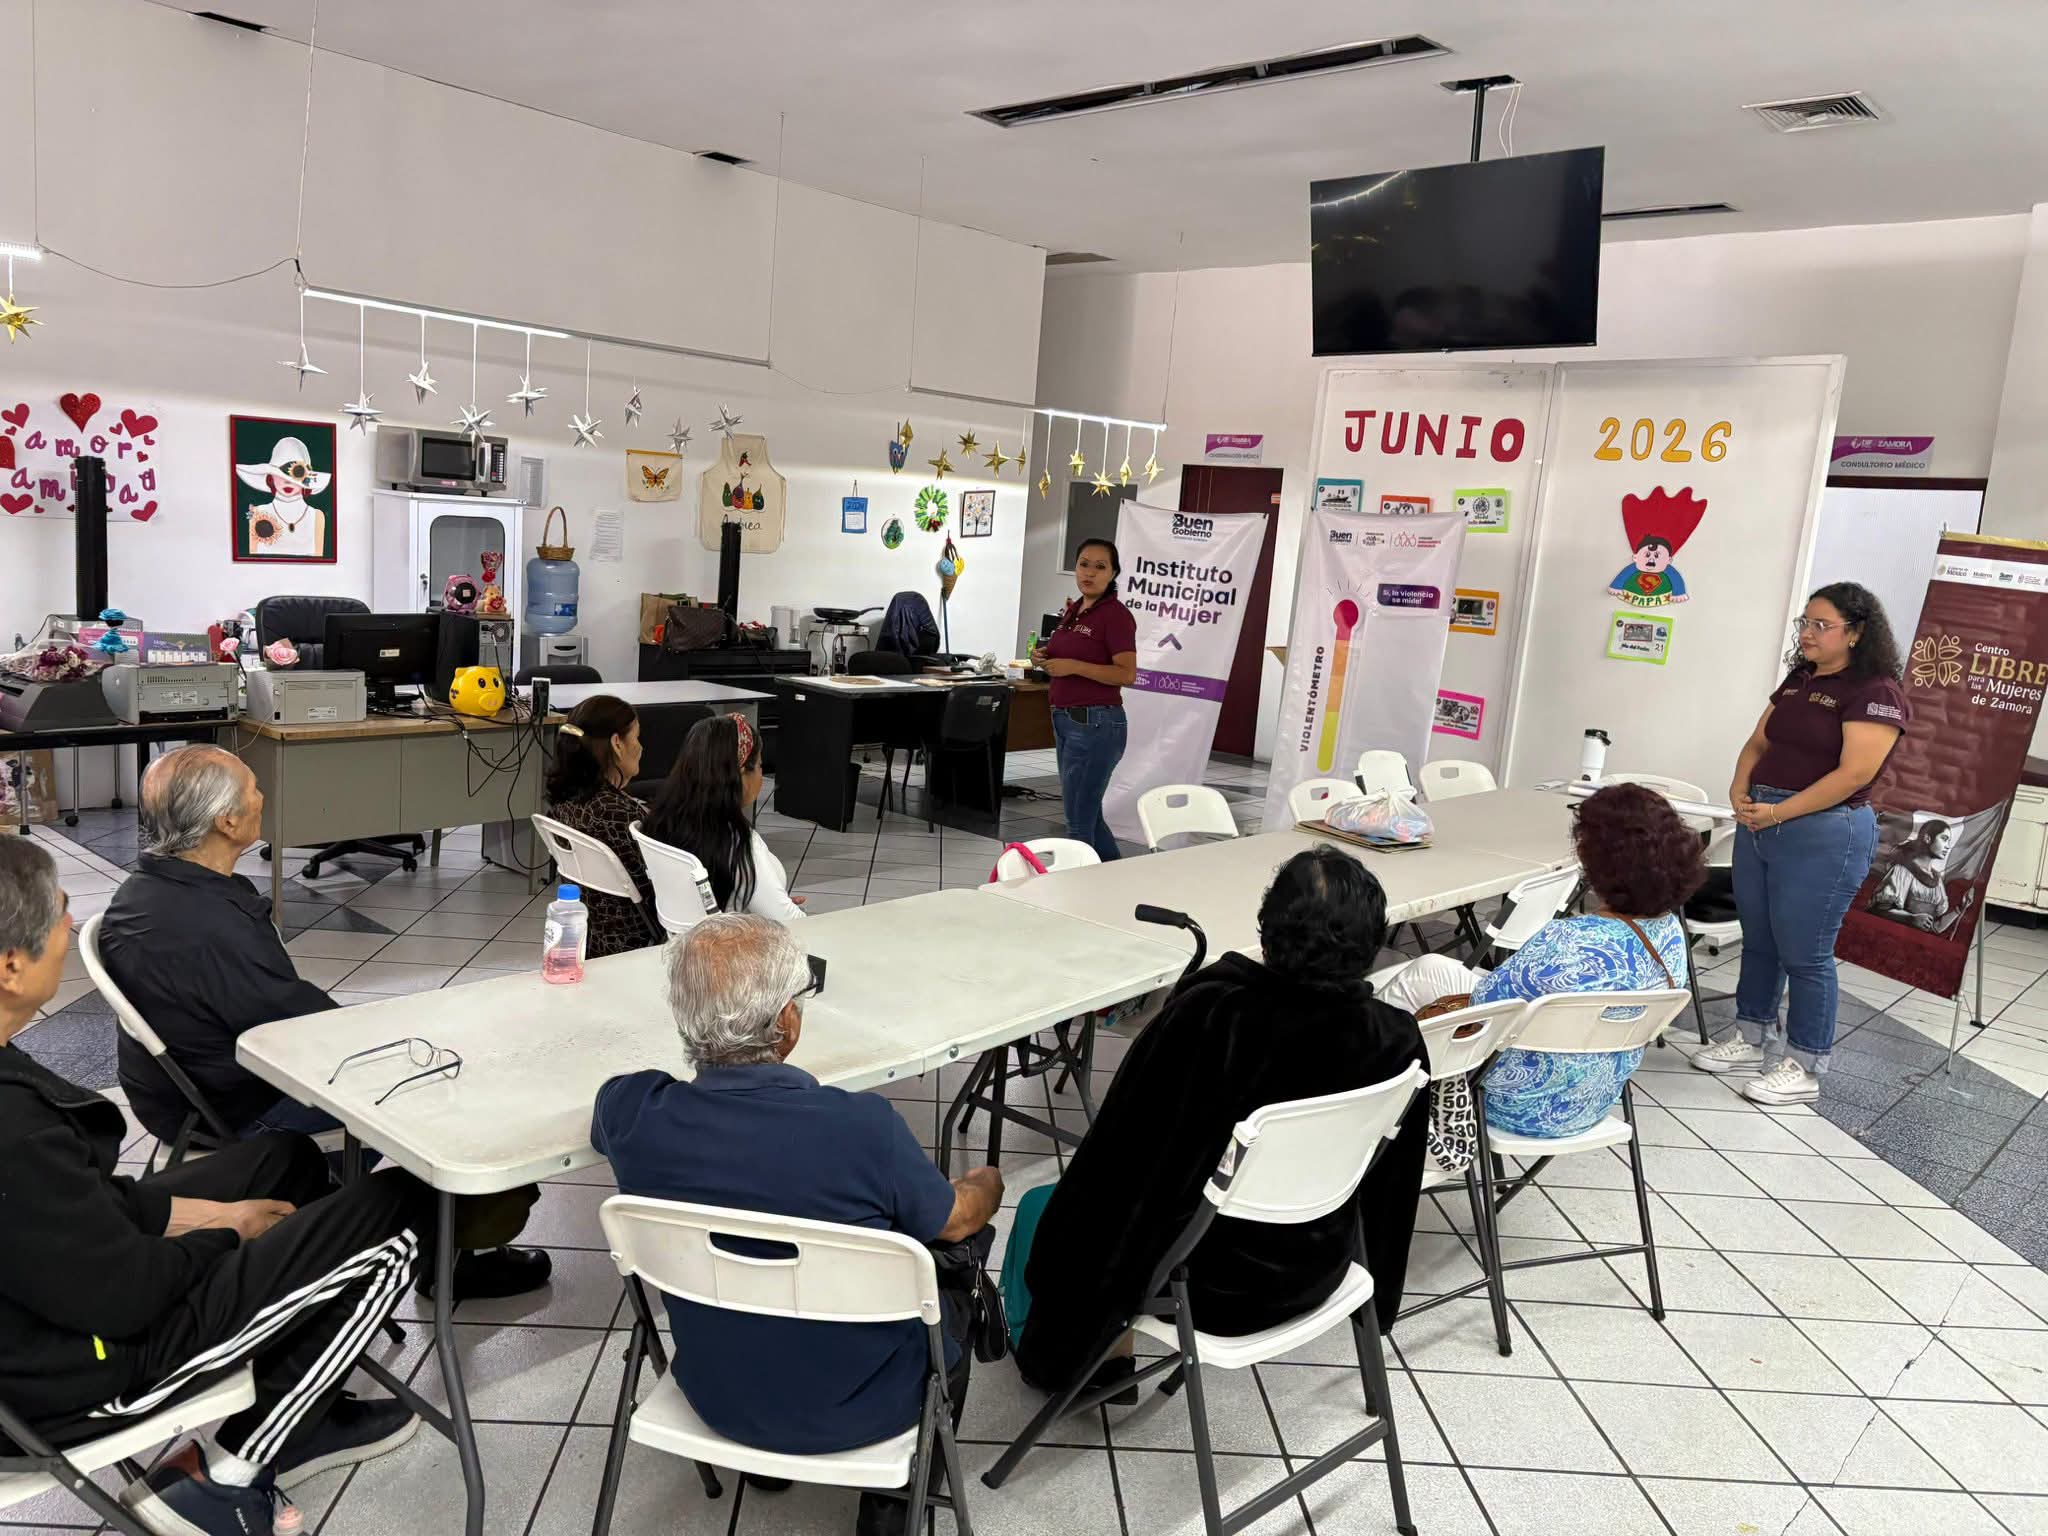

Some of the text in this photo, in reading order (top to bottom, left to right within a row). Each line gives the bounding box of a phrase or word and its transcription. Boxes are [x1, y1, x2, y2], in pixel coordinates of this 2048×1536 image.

[25, 431, 133, 460] amor
[1345, 410, 1732, 463] JUNIO 2026
[1878, 440, 1913, 451] ZAMORA
[1841, 460, 1926, 469] CONSULTORIO MÉDICO
[11, 462, 157, 505] amiad
[1172, 513, 1214, 531] Buen
[1172, 527, 1212, 539] Gobierno
[1330, 530, 1353, 540] Buen
[1136, 556, 1233, 584] Instituto
[1127, 576, 1237, 606] Municipal
[1400, 591, 1434, 599] violencia
[1125, 598, 1222, 626] de la Mujer
[1975, 643, 2010, 656] Centro
[1967, 674, 1985, 684] para
[1970, 653, 2048, 686] LIBRE
[1300, 646, 1325, 752] VIOLENTÓMETRO
[1970, 679, 2043, 701] las Mujeres
[1971, 694, 2033, 715] de Zamora
